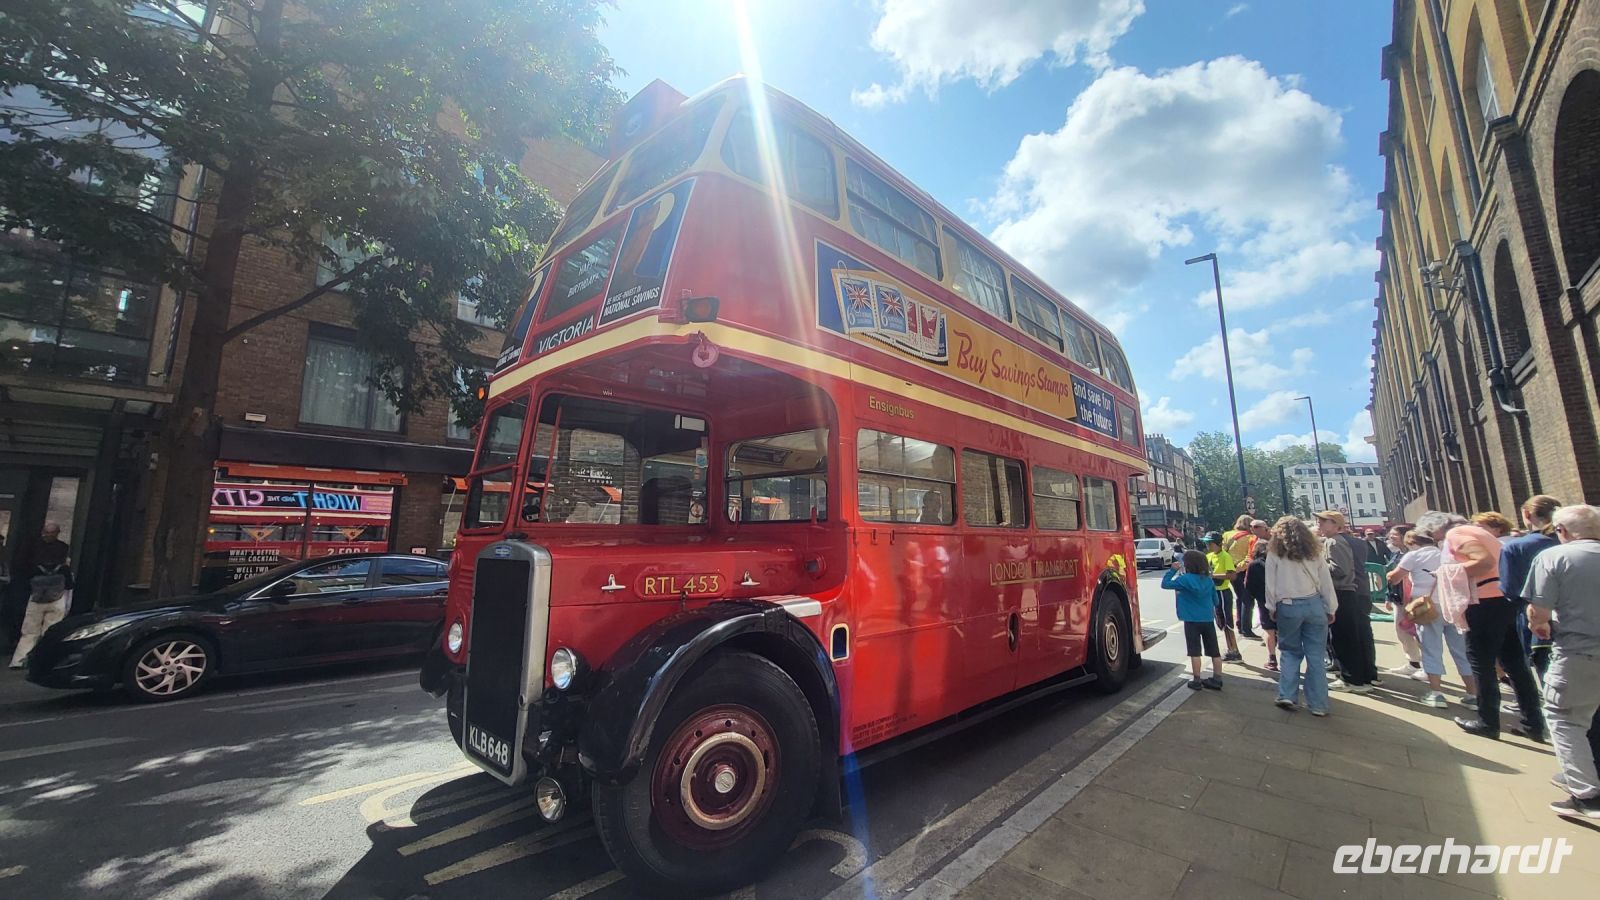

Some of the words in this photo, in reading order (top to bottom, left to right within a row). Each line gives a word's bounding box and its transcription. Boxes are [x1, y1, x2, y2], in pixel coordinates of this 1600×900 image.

[603, 298, 631, 317] NATIONAL
[631, 286, 660, 306] SAVINGS
[537, 315, 594, 354] VICTORIA
[953, 329, 988, 383] Buy
[991, 351, 1036, 398] Savings
[1037, 372, 1069, 404] Stamps
[868, 395, 915, 420] Ensignbus
[1072, 381, 1086, 401] and
[1086, 388, 1101, 406] save
[1101, 391, 1112, 411] for
[1080, 403, 1093, 422] the
[1093, 405, 1113, 432] future
[644, 576, 682, 595] RTL
[683, 574, 720, 595] 453
[989, 561, 1032, 584] LONDON
[1035, 559, 1079, 577] TRANSPORT
[468, 724, 509, 767] KLB648
